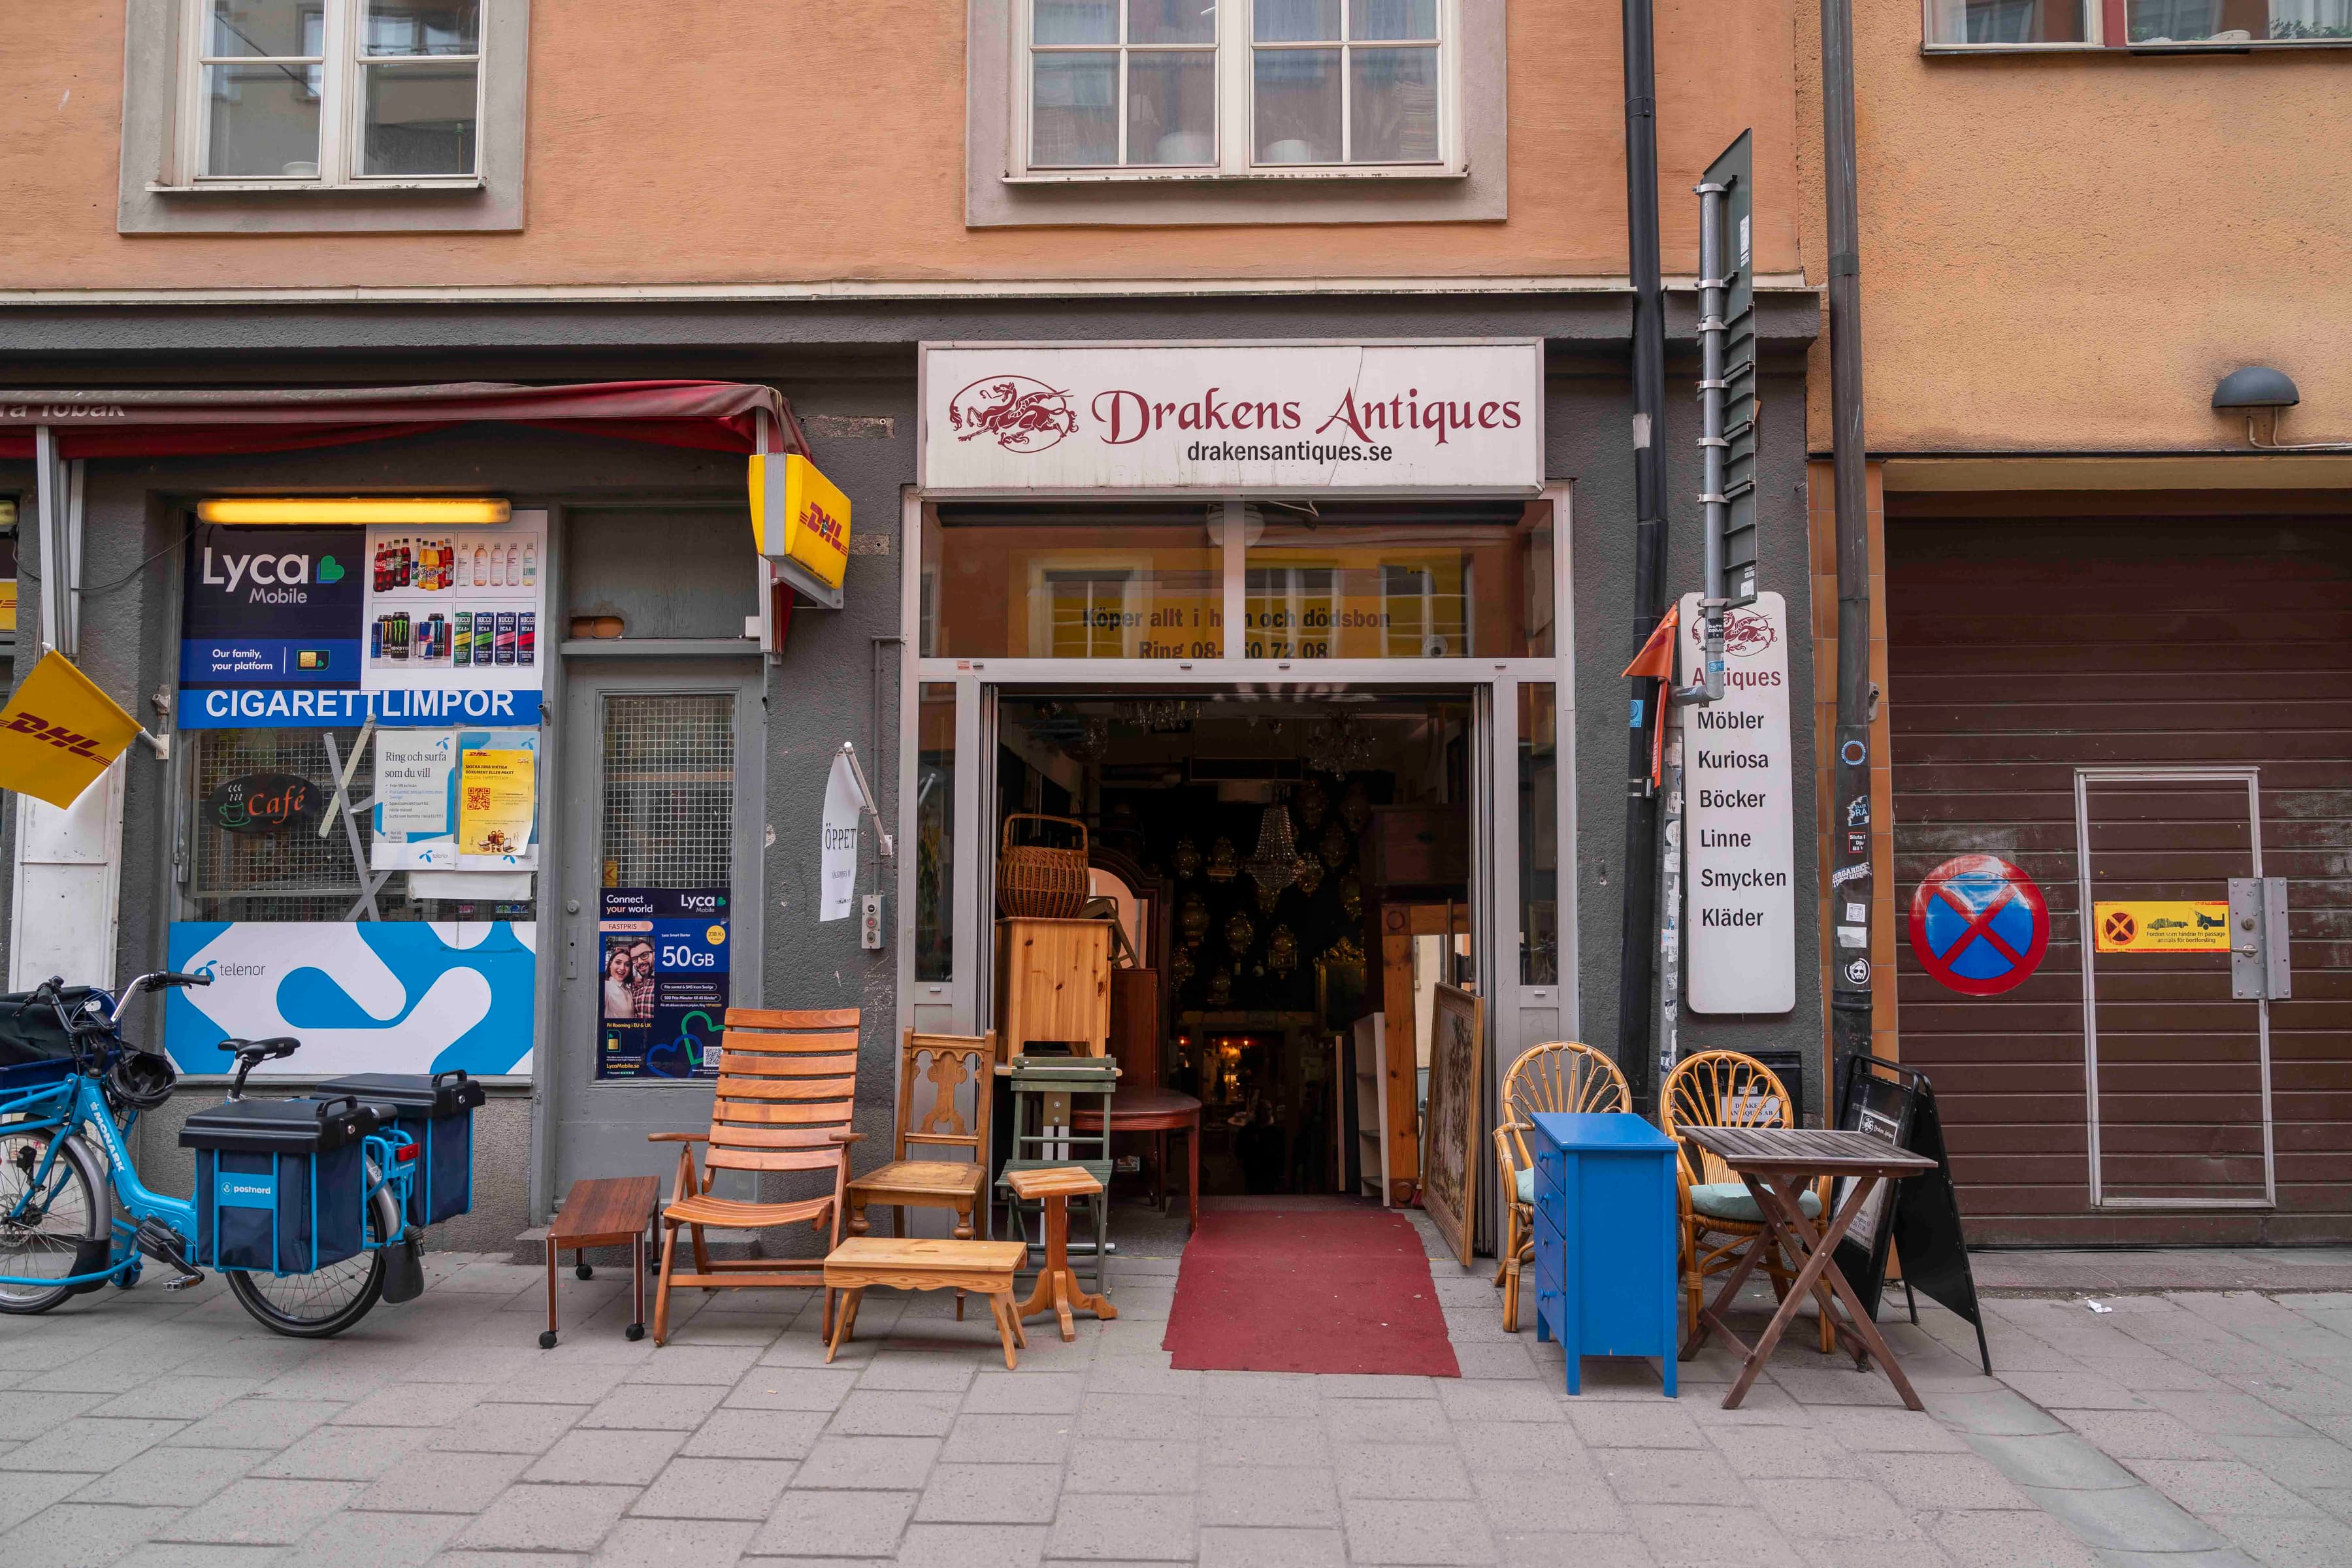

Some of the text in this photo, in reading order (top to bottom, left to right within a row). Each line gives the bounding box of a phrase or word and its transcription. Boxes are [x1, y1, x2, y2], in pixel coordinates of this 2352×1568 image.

[1092, 387, 1521, 447] Drakens Antiques
[1187, 440, 1392, 465] drakensantiques.se
[807, 501, 842, 551] DHL
[203, 547, 308, 592] Lyca
[249, 587, 308, 604] Mobile
[1083, 607, 1143, 631] Köper
[1150, 608, 1183, 627] allt
[1194, 608, 1199, 627] i
[1260, 609, 1296, 628] och
[1303, 608, 1390, 628] dödsbon
[212, 648, 261, 659] Our family,
[1139, 641, 1184, 659] Ring
[1271, 642, 1295, 659] 72
[1303, 642, 1328, 659] 08
[212, 661, 273, 672] your platform
[1692, 668, 1781, 690] Aiques
[206, 690, 515, 717] CIGARETTLIMPOR
[1697, 711, 1764, 729] Möbler
[7, 711, 101, 758] DHL
[385, 751, 447, 763] Ring och surfa
[1699, 751, 1769, 768] Kuriosa
[404, 768, 415, 777] du
[417, 768, 431, 777] vill
[248, 785, 306, 825] Café
[1700, 789, 1766, 808] Böcker
[825, 823, 857, 850] ÖPPET
[1701, 829, 1752, 847] Linne
[1701, 868, 1787, 891] Smycken
[606, 894, 715, 909] Connect Lyca
[606, 906, 627, 915] your
[1702, 908, 1764, 926] Kläder
[662, 945, 715, 967] 50GB
[220, 962, 266, 976] telenor
[93, 1112, 125, 1172] MONARK
[233, 1186, 271, 1194] postnord
